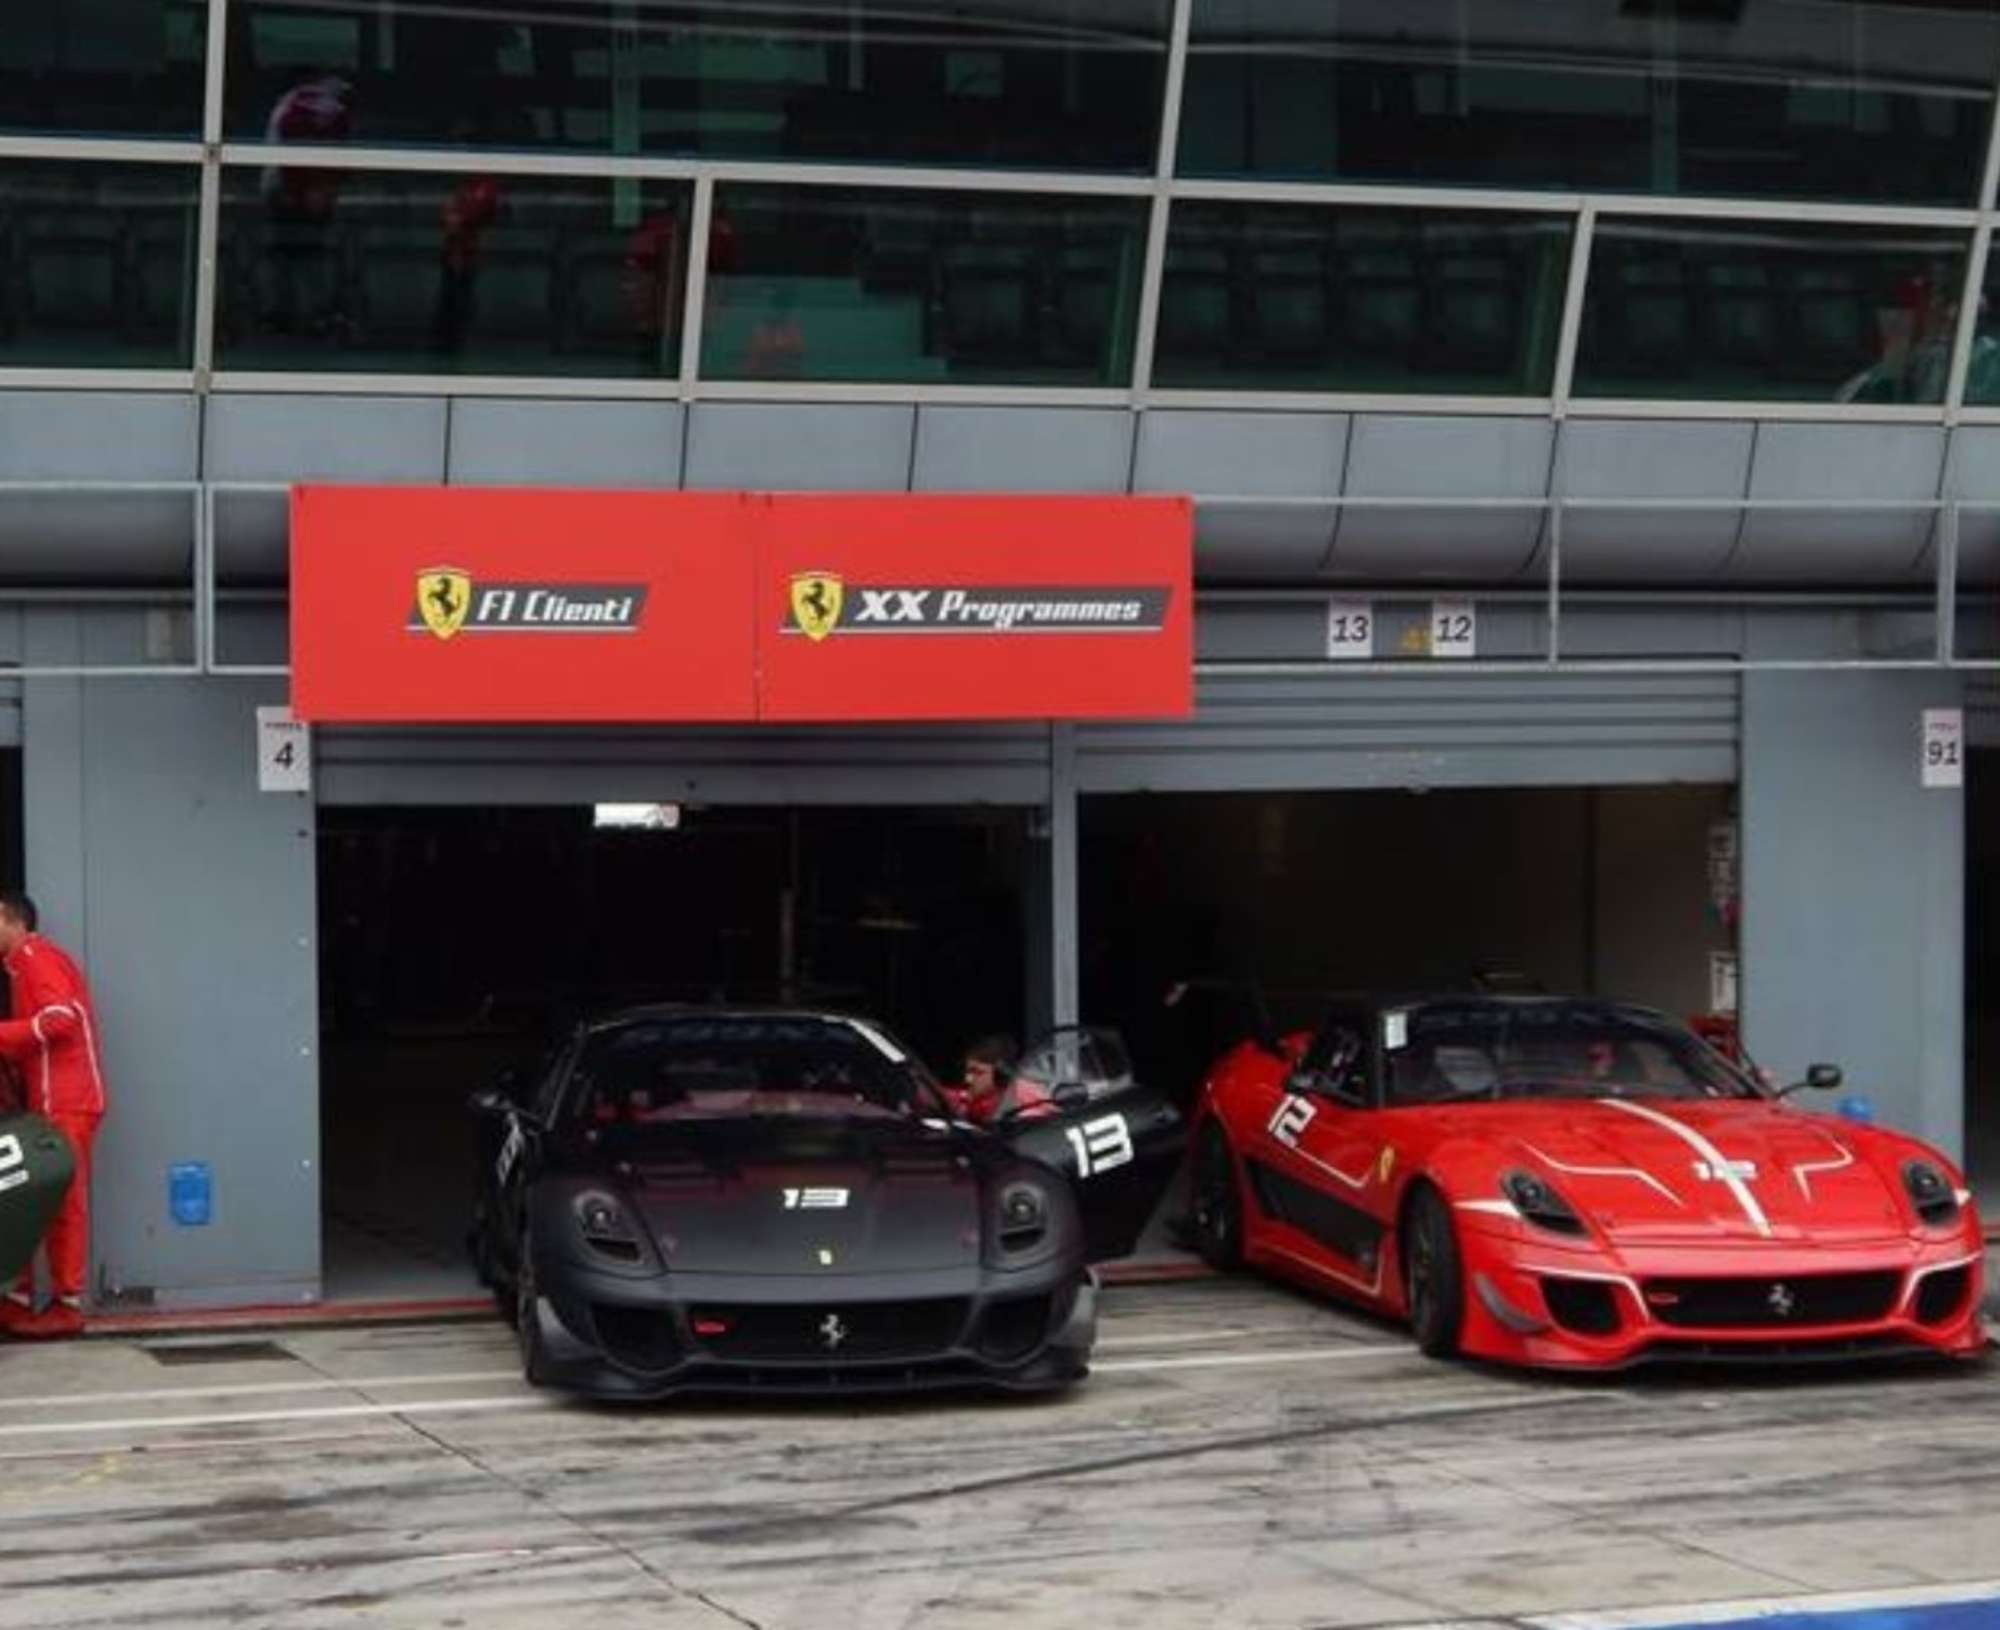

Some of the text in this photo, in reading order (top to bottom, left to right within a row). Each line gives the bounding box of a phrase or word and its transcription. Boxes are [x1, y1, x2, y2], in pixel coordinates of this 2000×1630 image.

[476, 590, 633, 621] F1 Clienti
[854, 590, 1142, 629] XX Programmes
[1333, 615, 1369, 643] 13
[1437, 615, 1472, 643] 12
[273, 740, 294, 770] 4
[1928, 741, 1959, 766] 91
[1267, 1093, 1318, 1149] 12
[1064, 1112, 1134, 1178] 13
[782, 1188, 850, 1209] 13
